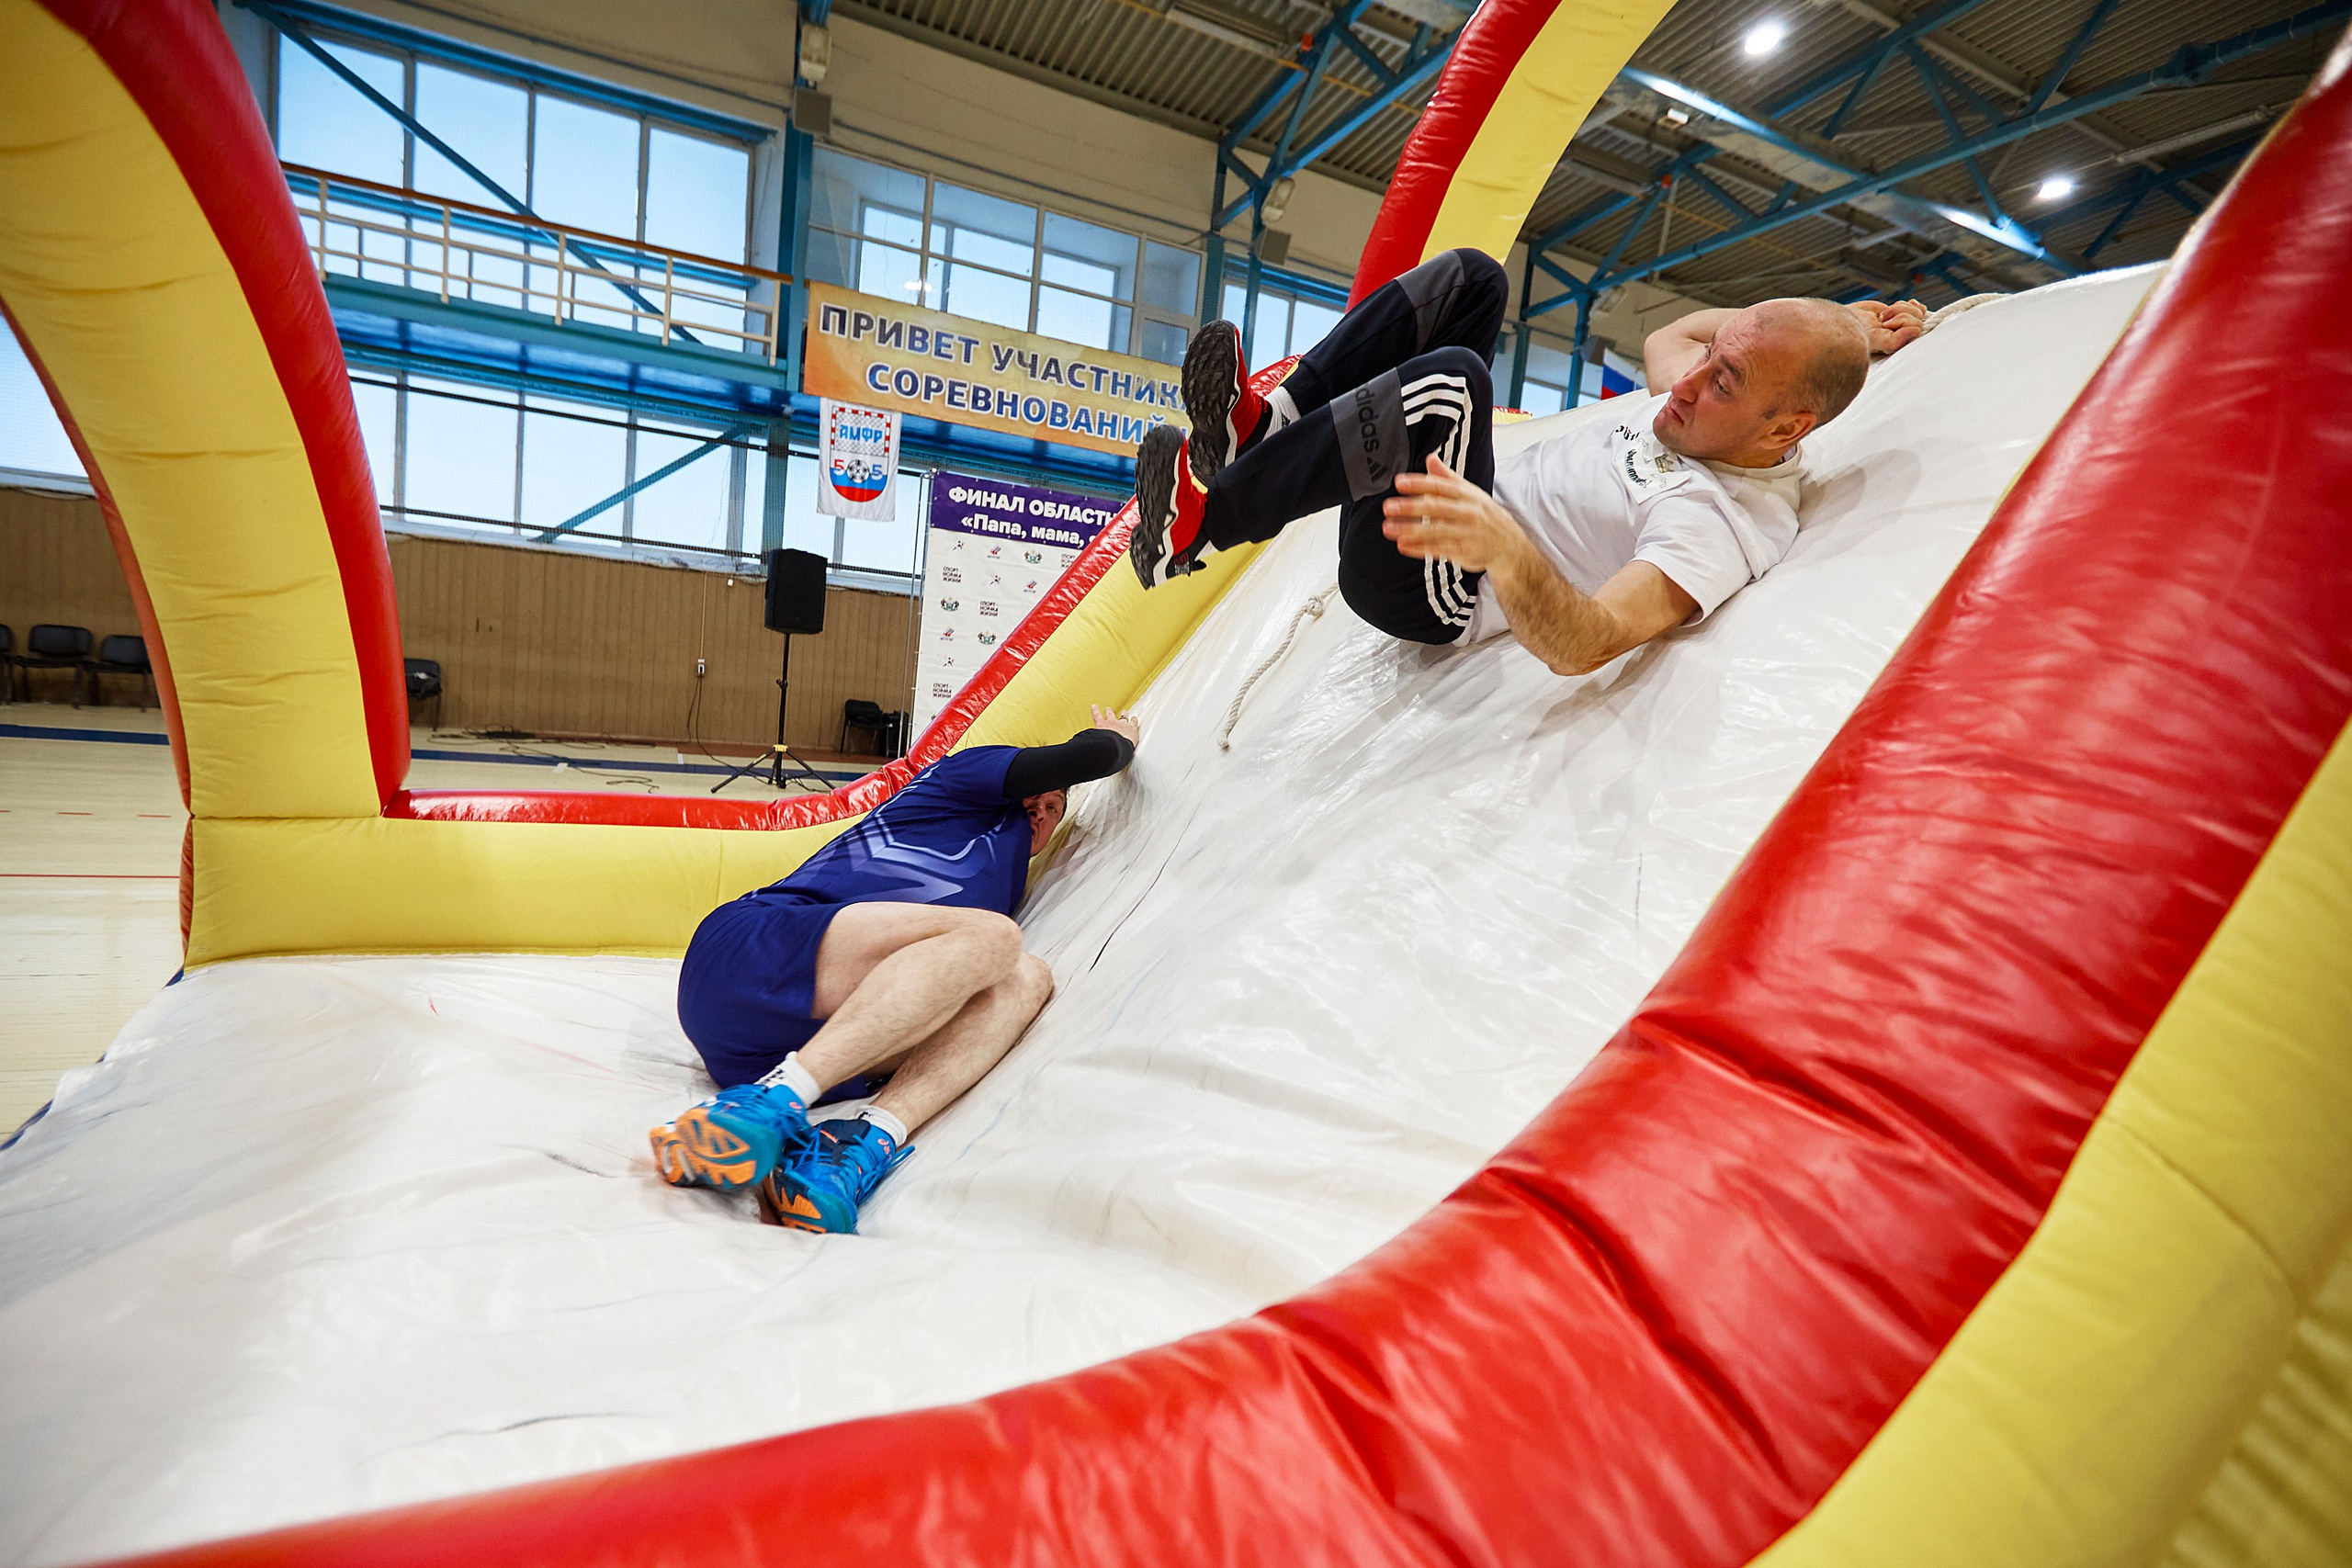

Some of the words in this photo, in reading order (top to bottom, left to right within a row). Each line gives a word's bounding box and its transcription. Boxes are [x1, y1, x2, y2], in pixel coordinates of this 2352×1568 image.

[820, 302, 981, 366] ПРИВЕТ
[990, 343, 1187, 412] УЧАСТНИК
[1354, 387, 1380, 453] didas
[833, 459, 845, 476] 5
[871, 464, 883, 480] 5
[948, 486, 1025, 513] ФИНАЛ
[961, 513, 1026, 539] «Папа,
[1031, 525, 1085, 548] мама,
